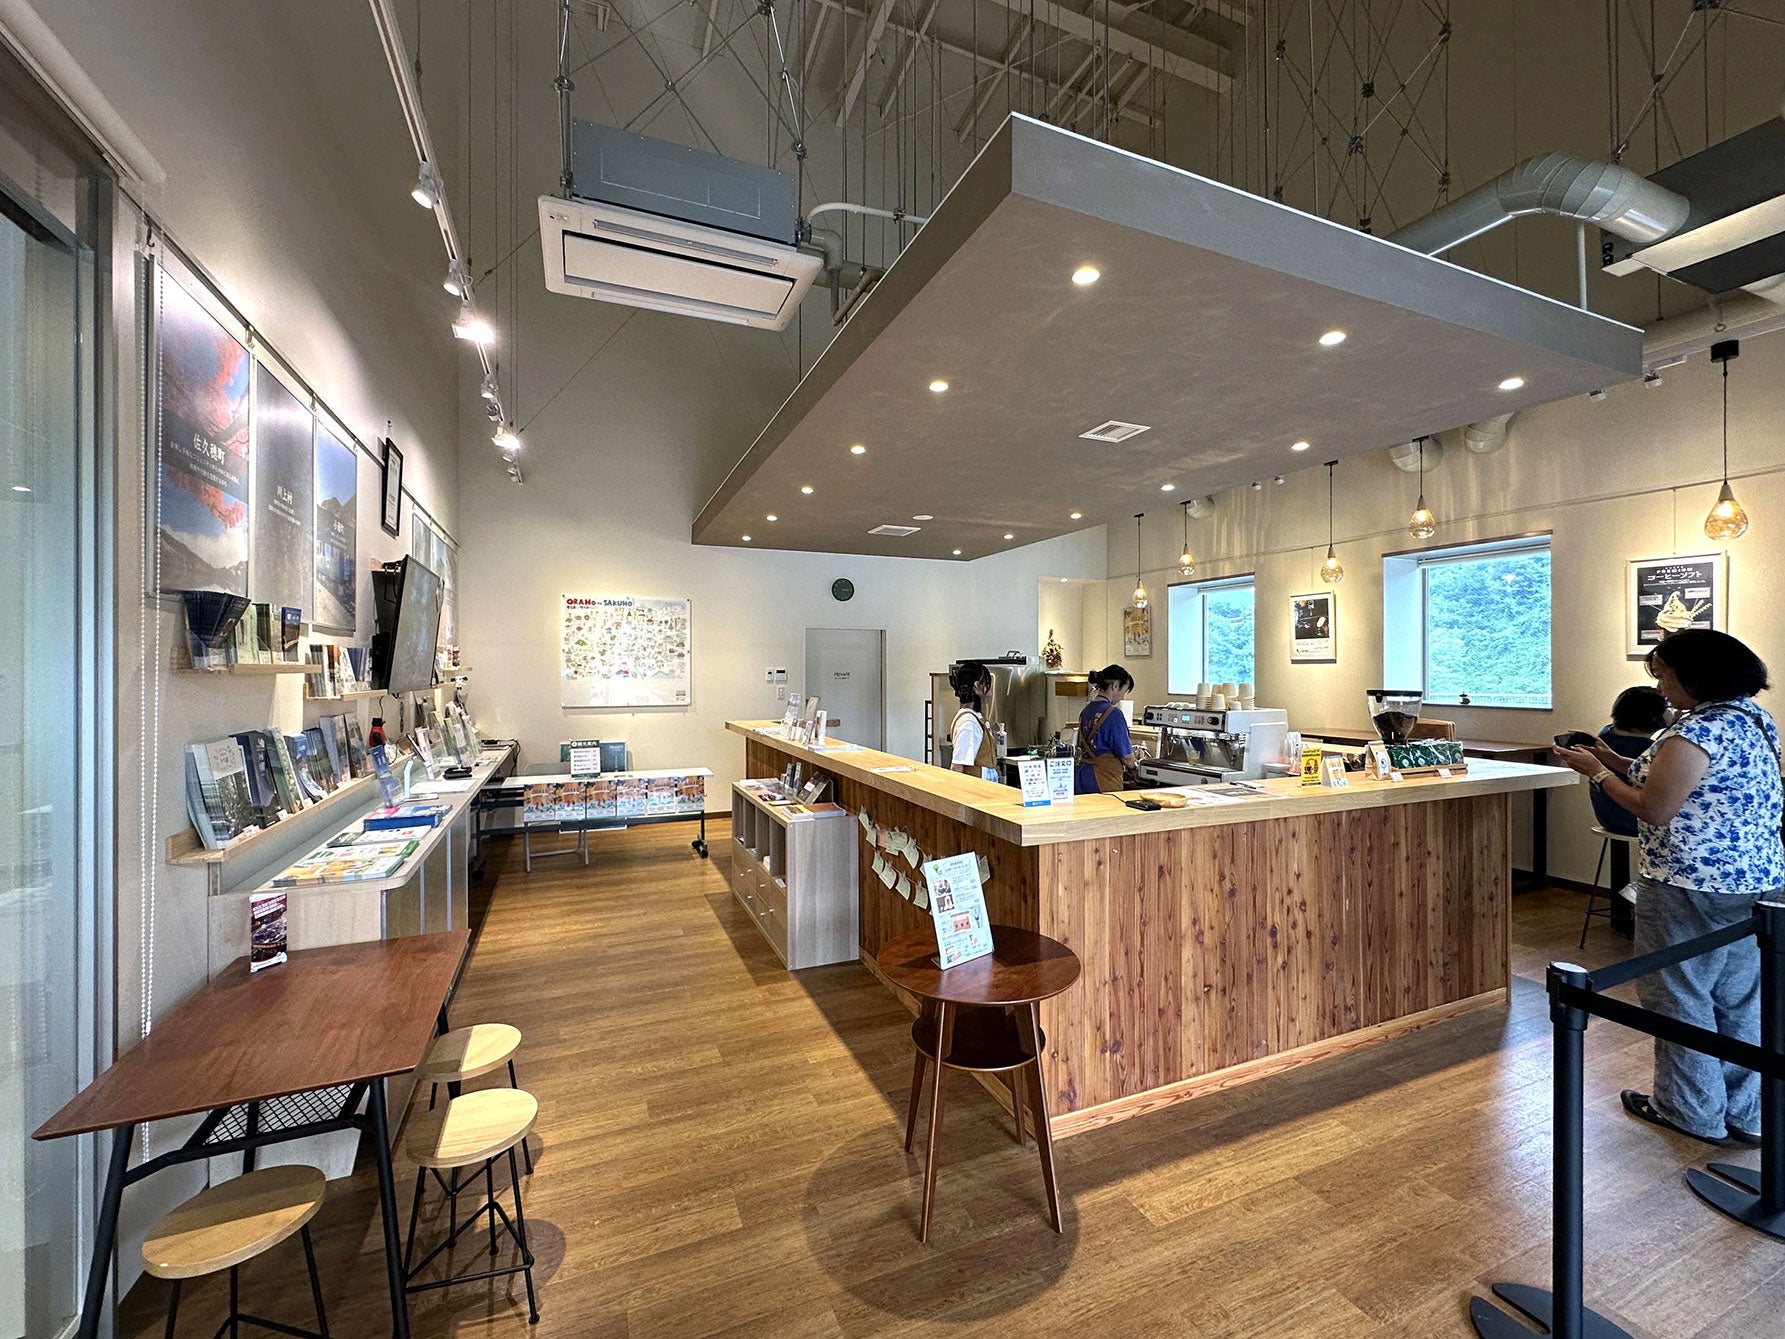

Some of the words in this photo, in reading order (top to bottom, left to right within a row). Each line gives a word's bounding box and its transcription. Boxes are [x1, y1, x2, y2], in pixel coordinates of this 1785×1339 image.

[1647, 571, 1702, 580] コーヒーソフト
